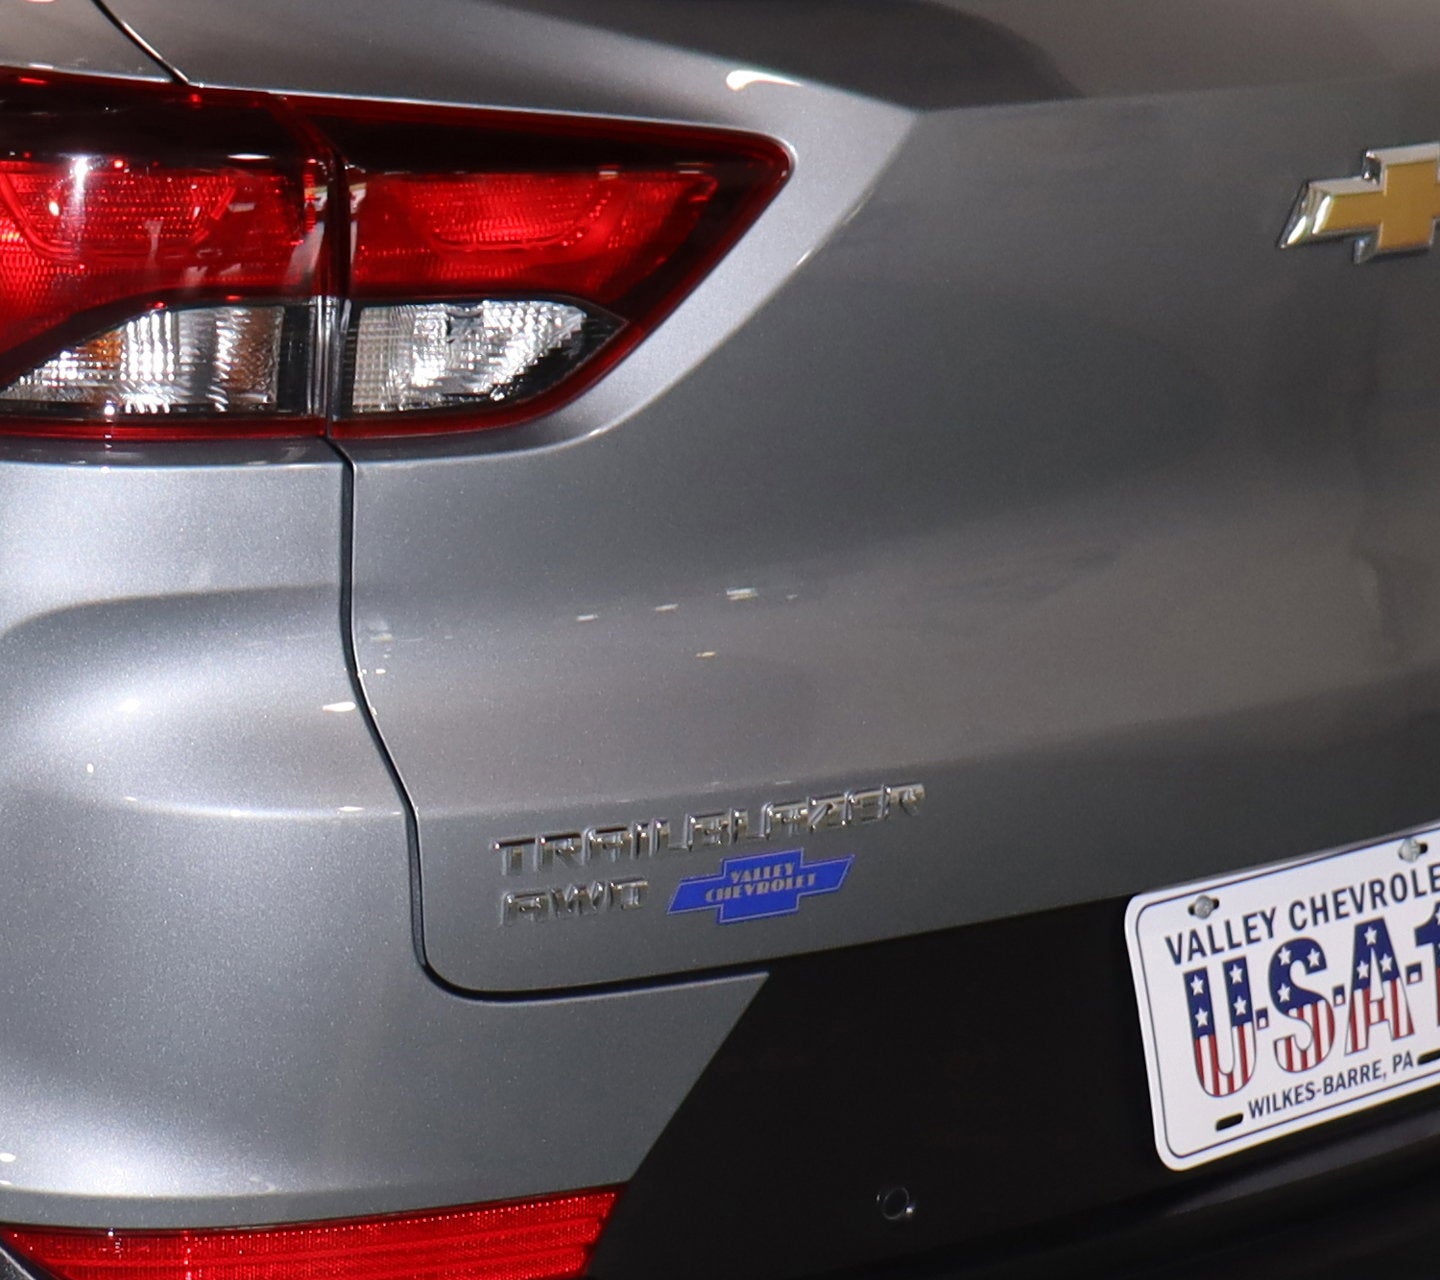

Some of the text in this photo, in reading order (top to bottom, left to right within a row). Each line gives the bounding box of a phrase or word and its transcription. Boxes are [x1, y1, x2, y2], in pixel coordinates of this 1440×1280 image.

[705, 873, 816, 903] CHEVROLET
[731, 862, 795, 884] VALLEY
[1165, 907, 1277, 965] VALLEY
[1247, 1051, 1415, 1118] WILKES-BARRE, PA
